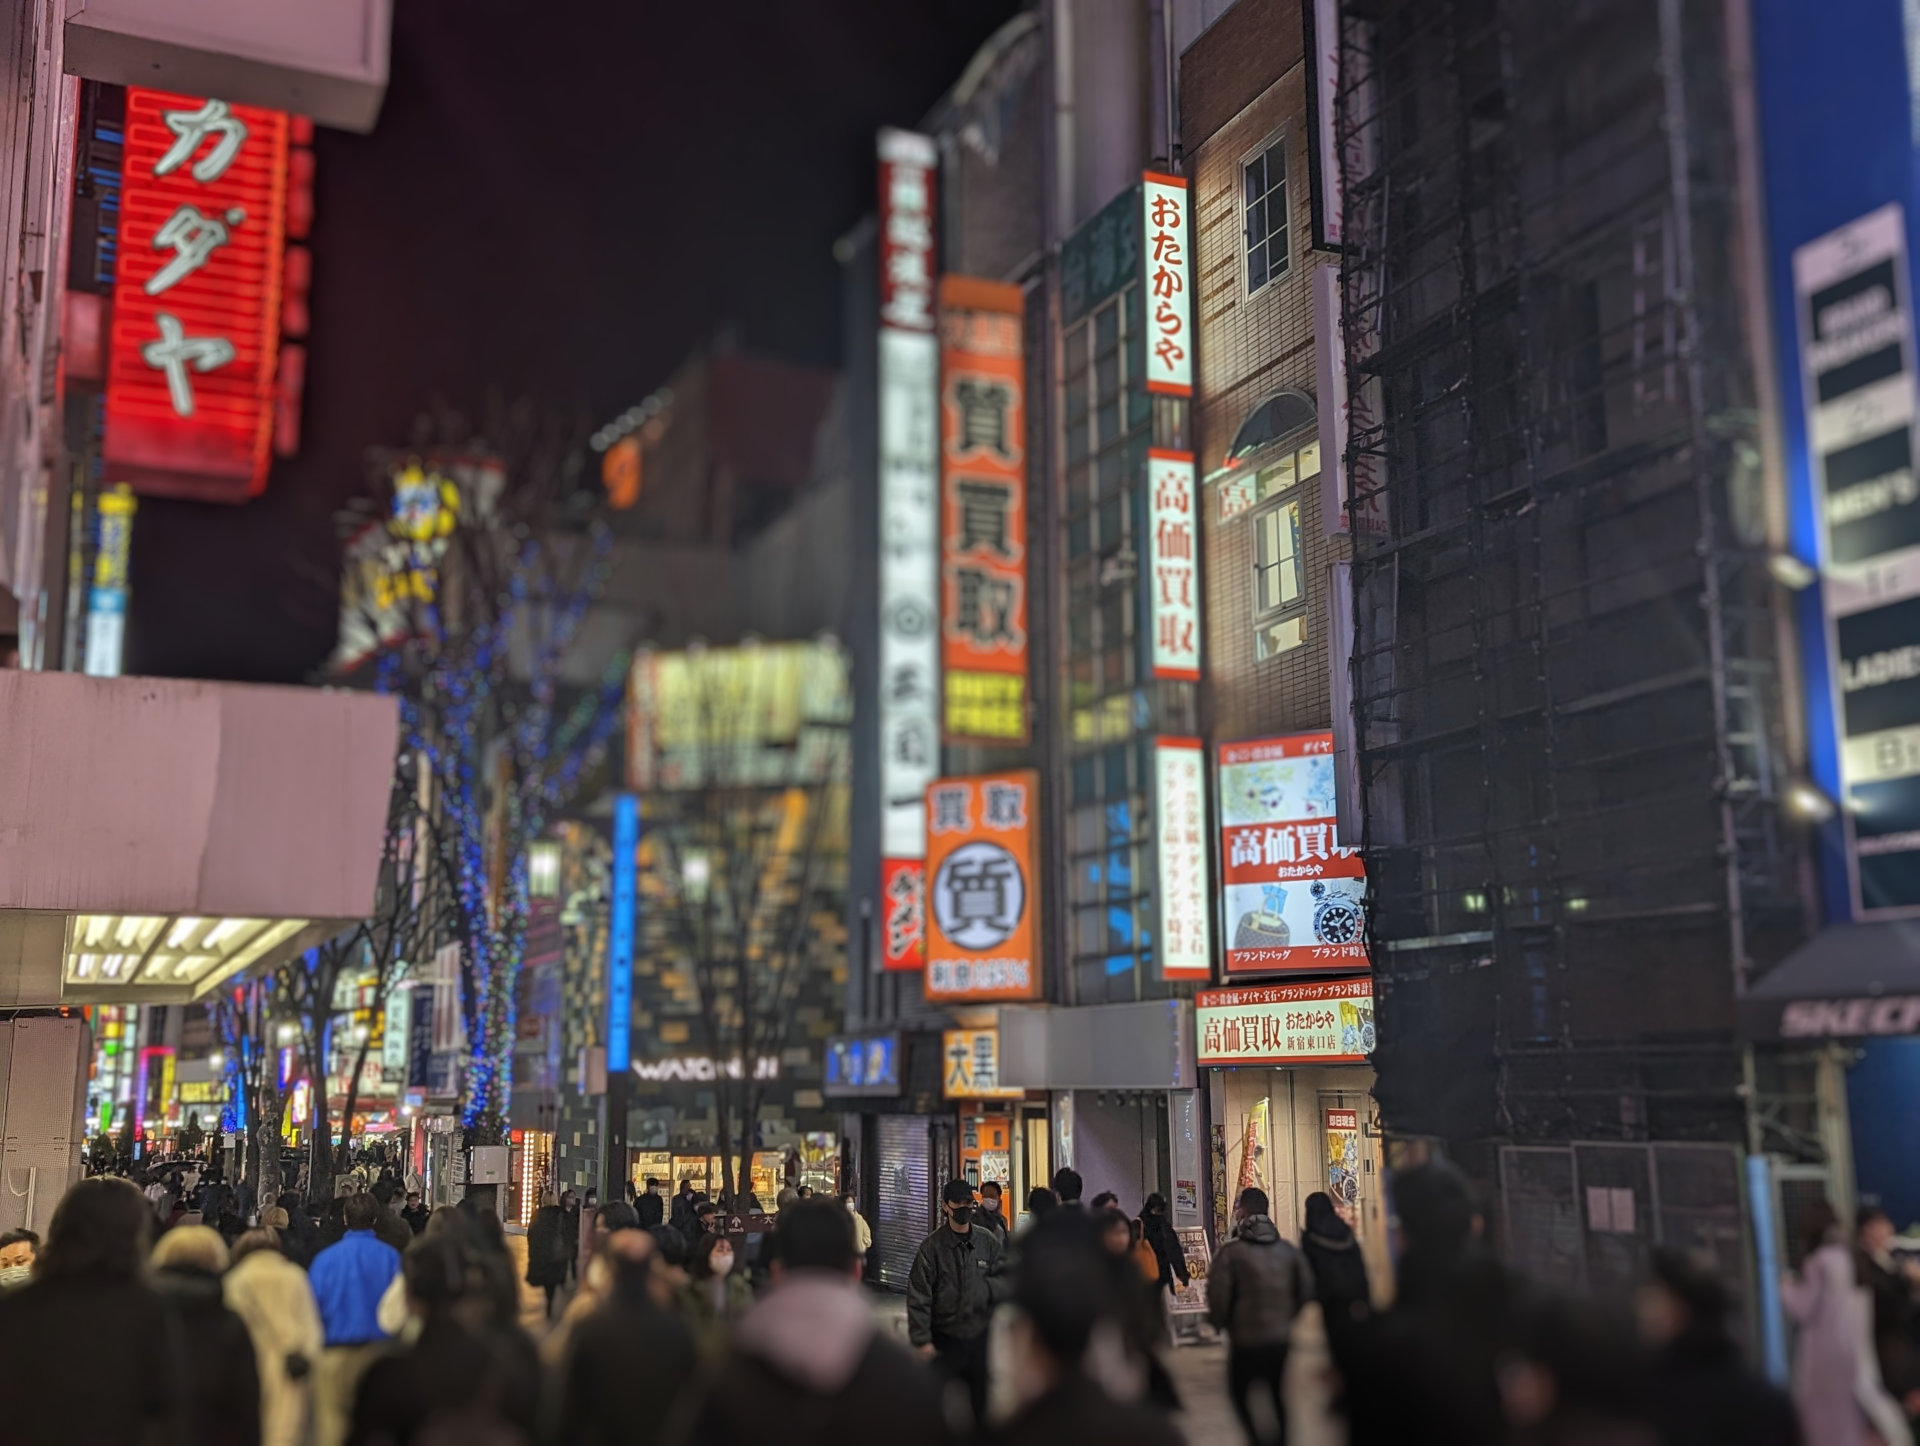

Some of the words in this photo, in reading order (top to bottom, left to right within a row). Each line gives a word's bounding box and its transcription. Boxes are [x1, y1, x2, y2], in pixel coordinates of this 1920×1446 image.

[1151, 193, 1186, 372] おたからや
[1153, 470, 1194, 656] 高価買取
[930, 781, 1027, 833] 買取
[1278, 865, 1323, 879] おたからや
[946, 858, 1011, 933] 質
[1234, 949, 1291, 963] ブランドバッグ
[1204, 1014, 1282, 1053] 高価買取
[1285, 1010, 1335, 1031] おたからや
[1287, 1034, 1336, 1051] 新宿東口店
